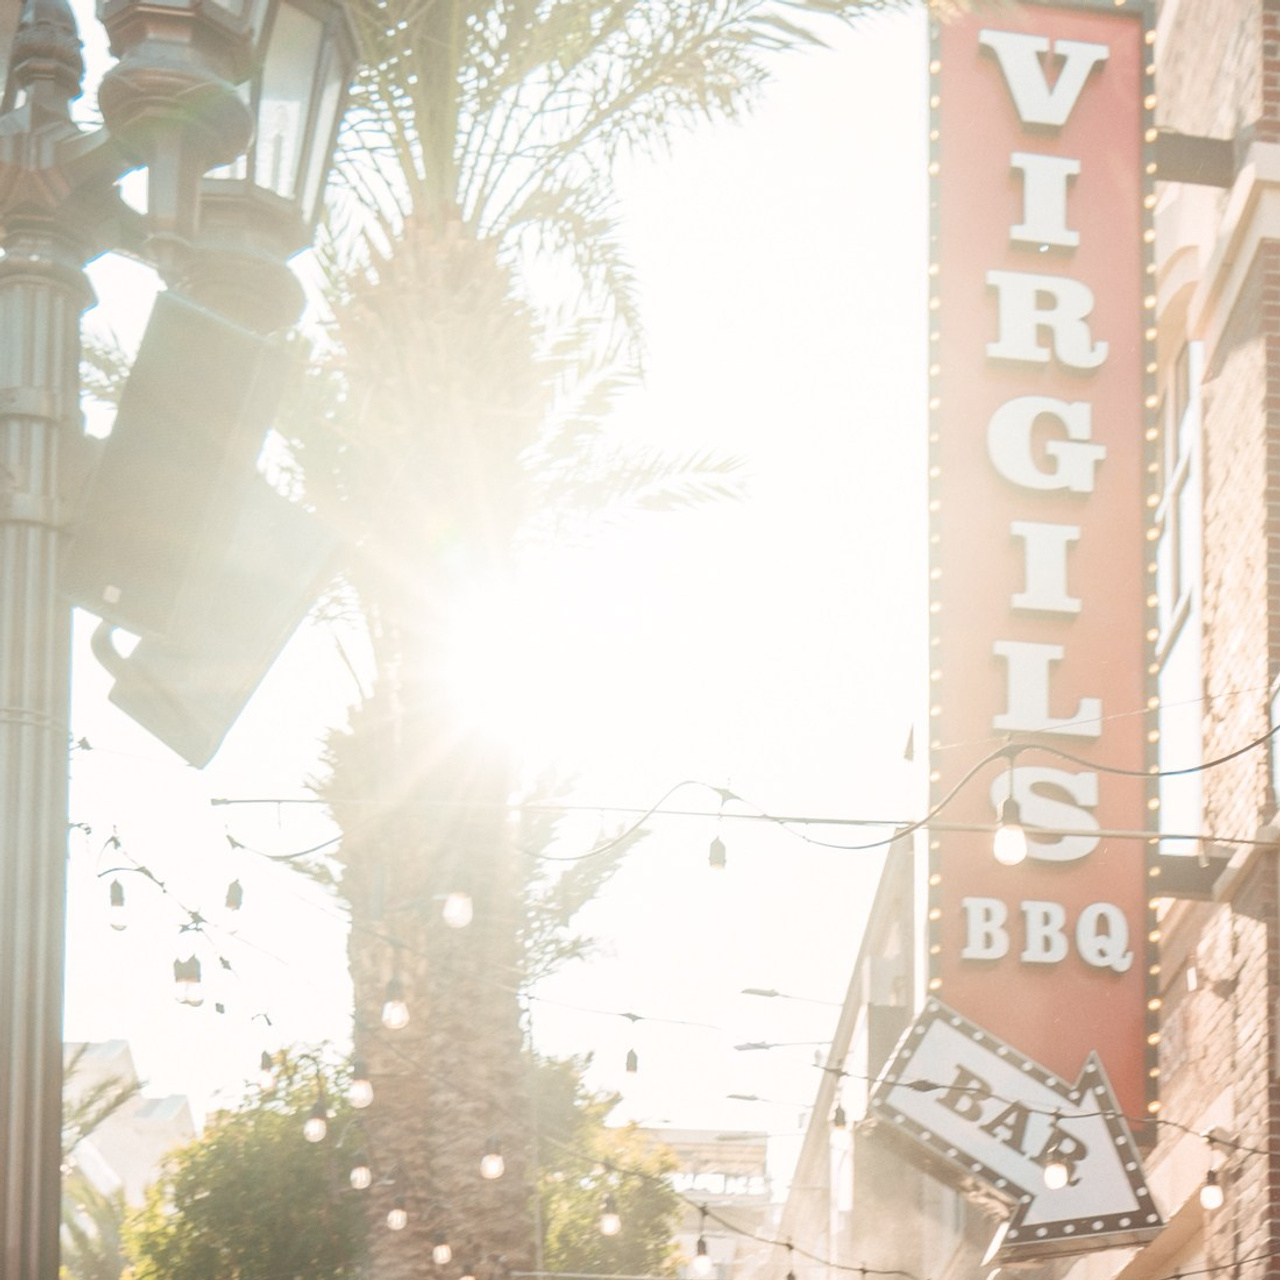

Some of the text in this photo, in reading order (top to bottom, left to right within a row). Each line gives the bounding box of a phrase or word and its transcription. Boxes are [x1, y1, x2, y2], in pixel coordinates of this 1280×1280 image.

[978, 29, 1110, 862] VIRGILS
[961, 896, 1134, 974] BBQ
[935, 1063, 1088, 1187] BAR
